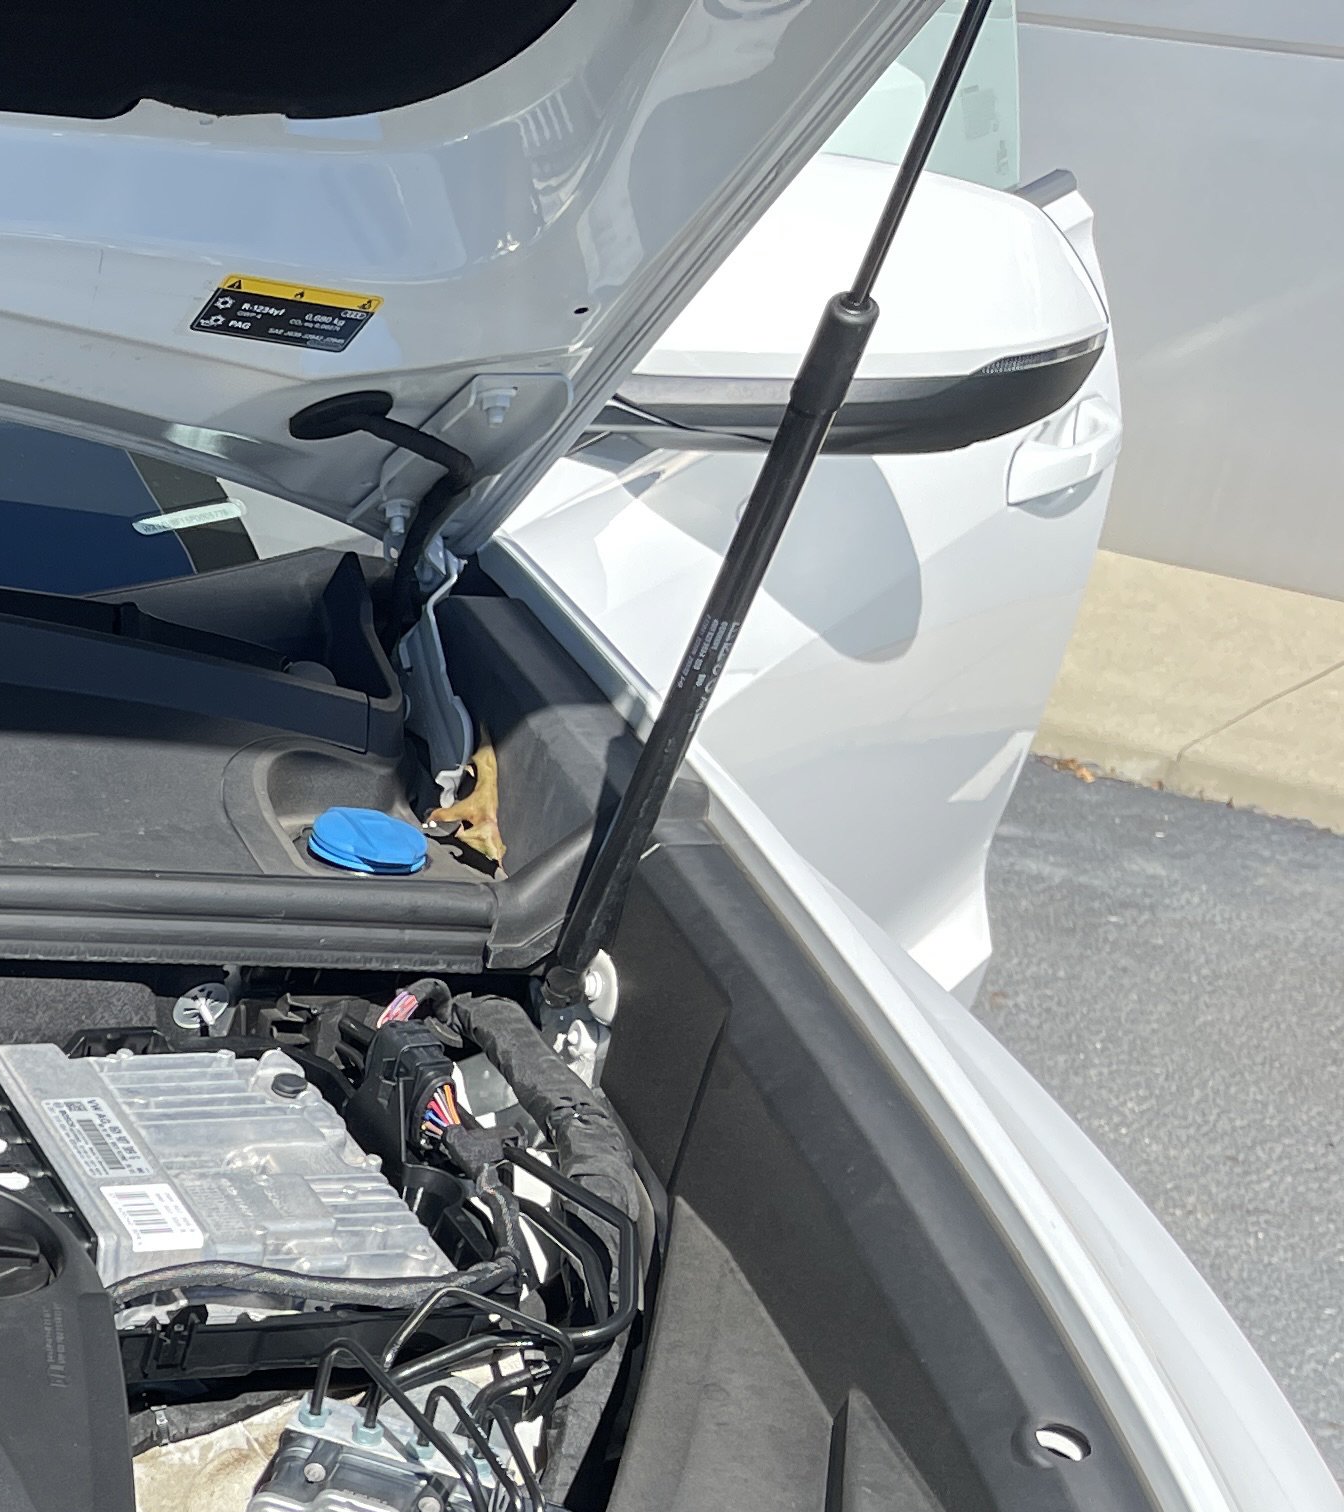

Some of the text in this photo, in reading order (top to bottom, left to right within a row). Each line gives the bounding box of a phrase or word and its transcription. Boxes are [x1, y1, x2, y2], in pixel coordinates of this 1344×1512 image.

[242, 303, 285, 316] R-1234yf
[229, 321, 251, 329] PAG
[334, 318, 346, 326] kg
